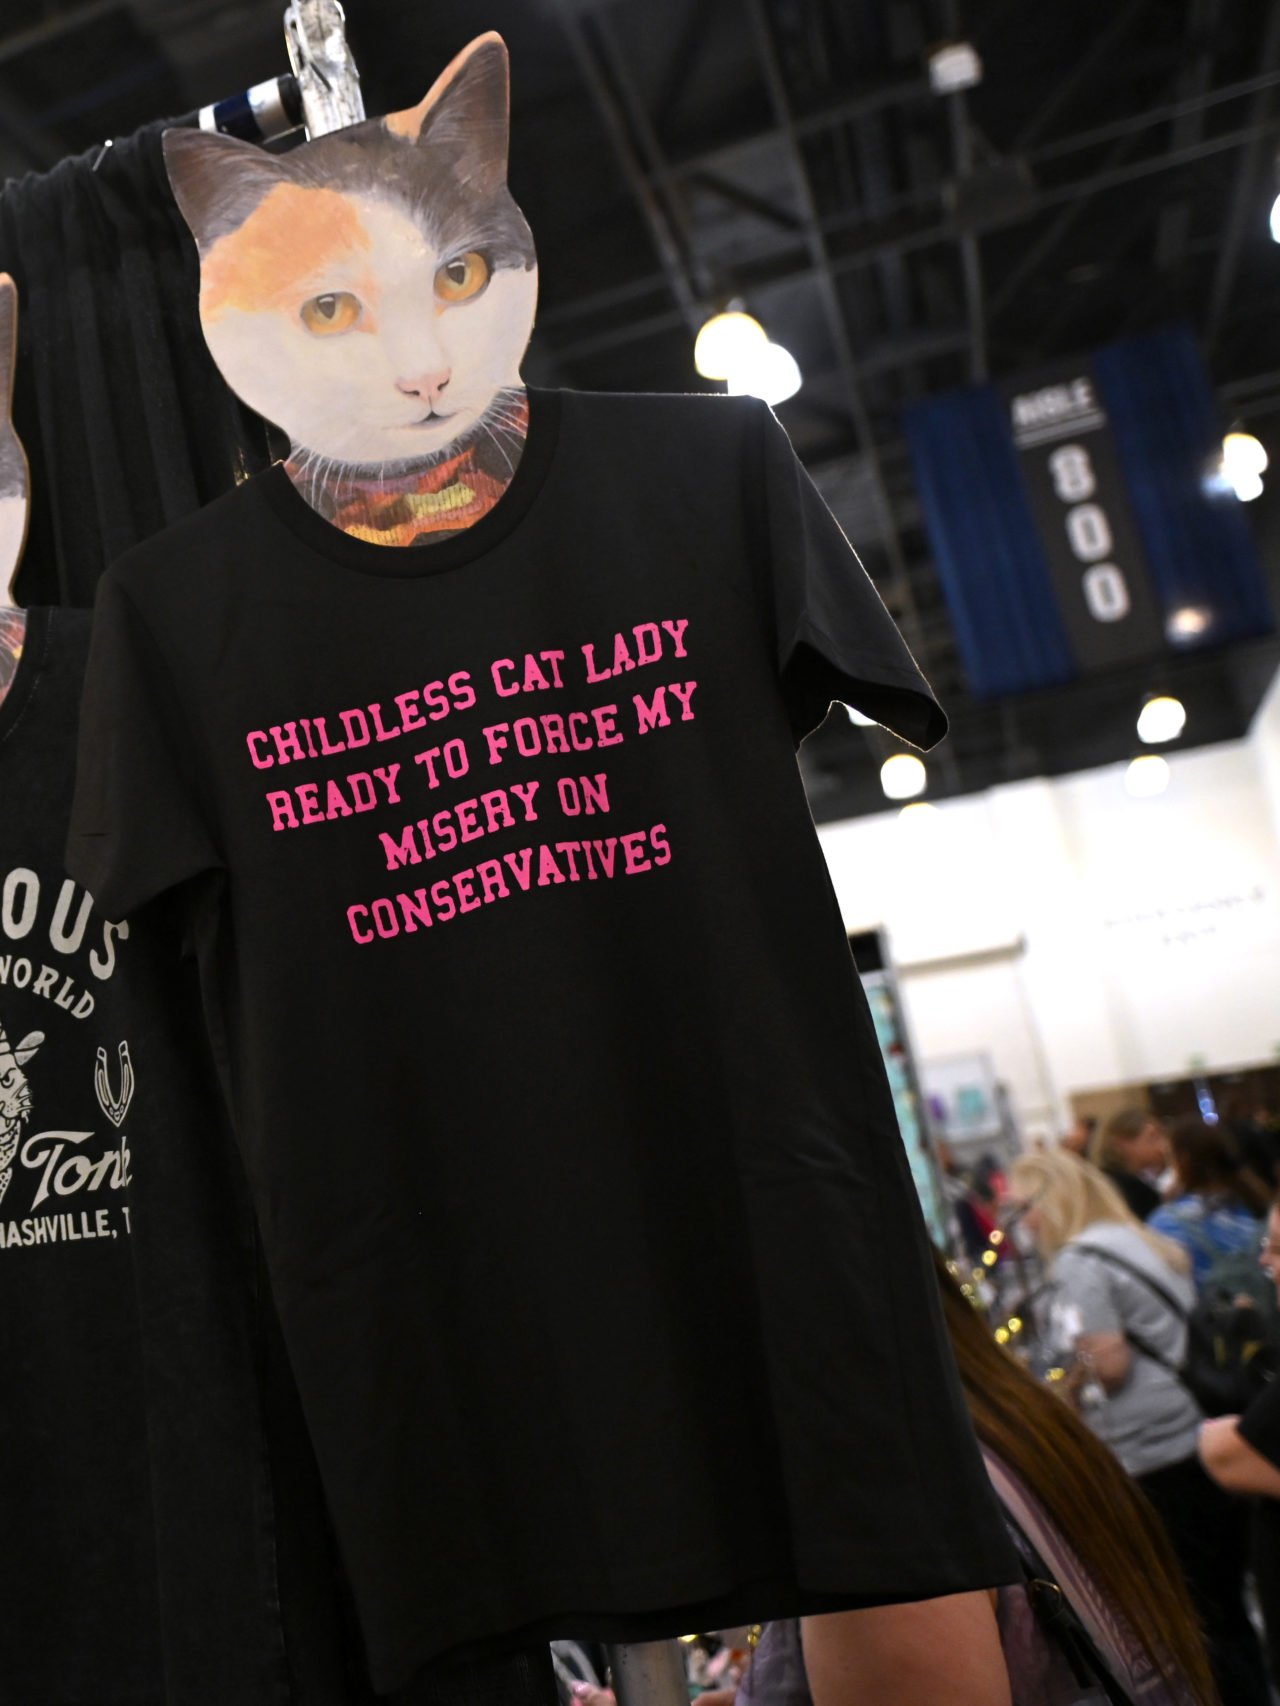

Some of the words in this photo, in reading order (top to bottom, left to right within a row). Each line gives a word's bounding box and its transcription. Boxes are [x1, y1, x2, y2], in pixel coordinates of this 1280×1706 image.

[1048, 444, 1131, 622] 800
[246, 671, 477, 769] CHILDLESS
[491, 650, 565, 697] CAT
[581, 619, 689, 684] LADY
[266, 763, 401, 831] READY
[414, 738, 469, 790] TO
[482, 704, 623, 765] FORCE
[633, 681, 697, 734] MY
[346, 824, 672, 945] CONSERVATIVES
[378, 781, 539, 871] MISERY
[557, 774, 610, 816] ON
